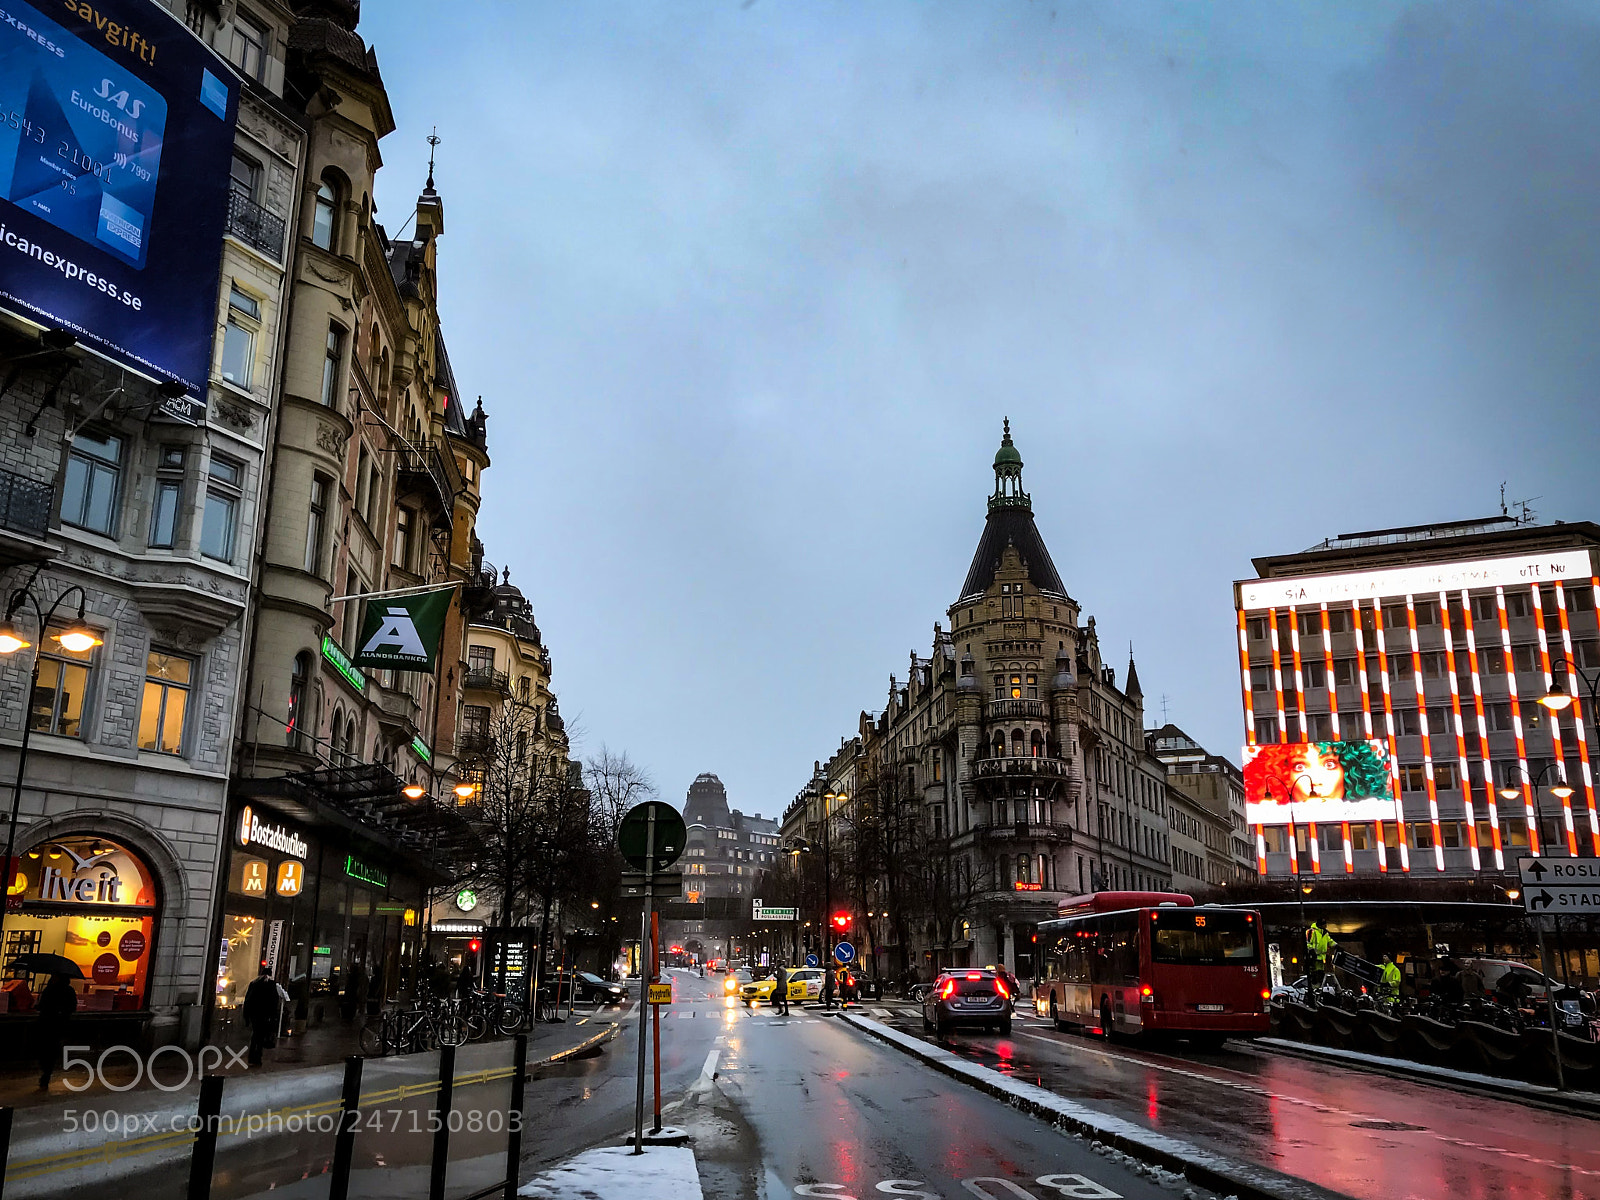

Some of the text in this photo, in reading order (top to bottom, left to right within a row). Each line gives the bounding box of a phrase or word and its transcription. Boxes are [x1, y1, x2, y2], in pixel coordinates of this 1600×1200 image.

[70, 90, 139, 143] EuroBonus
[93, 79, 146, 119] SAS
[57, 141, 113, 185] 21001
[0, 223, 142, 311] icanexpress.se
[250, 814, 308, 860] Bostadsbutiken
[1553, 864, 1600, 877] ROSL
[431, 925, 477, 933] STARBUCKS
[1195, 916, 1206, 927] 55
[1243, 965, 1259, 973] 7485
